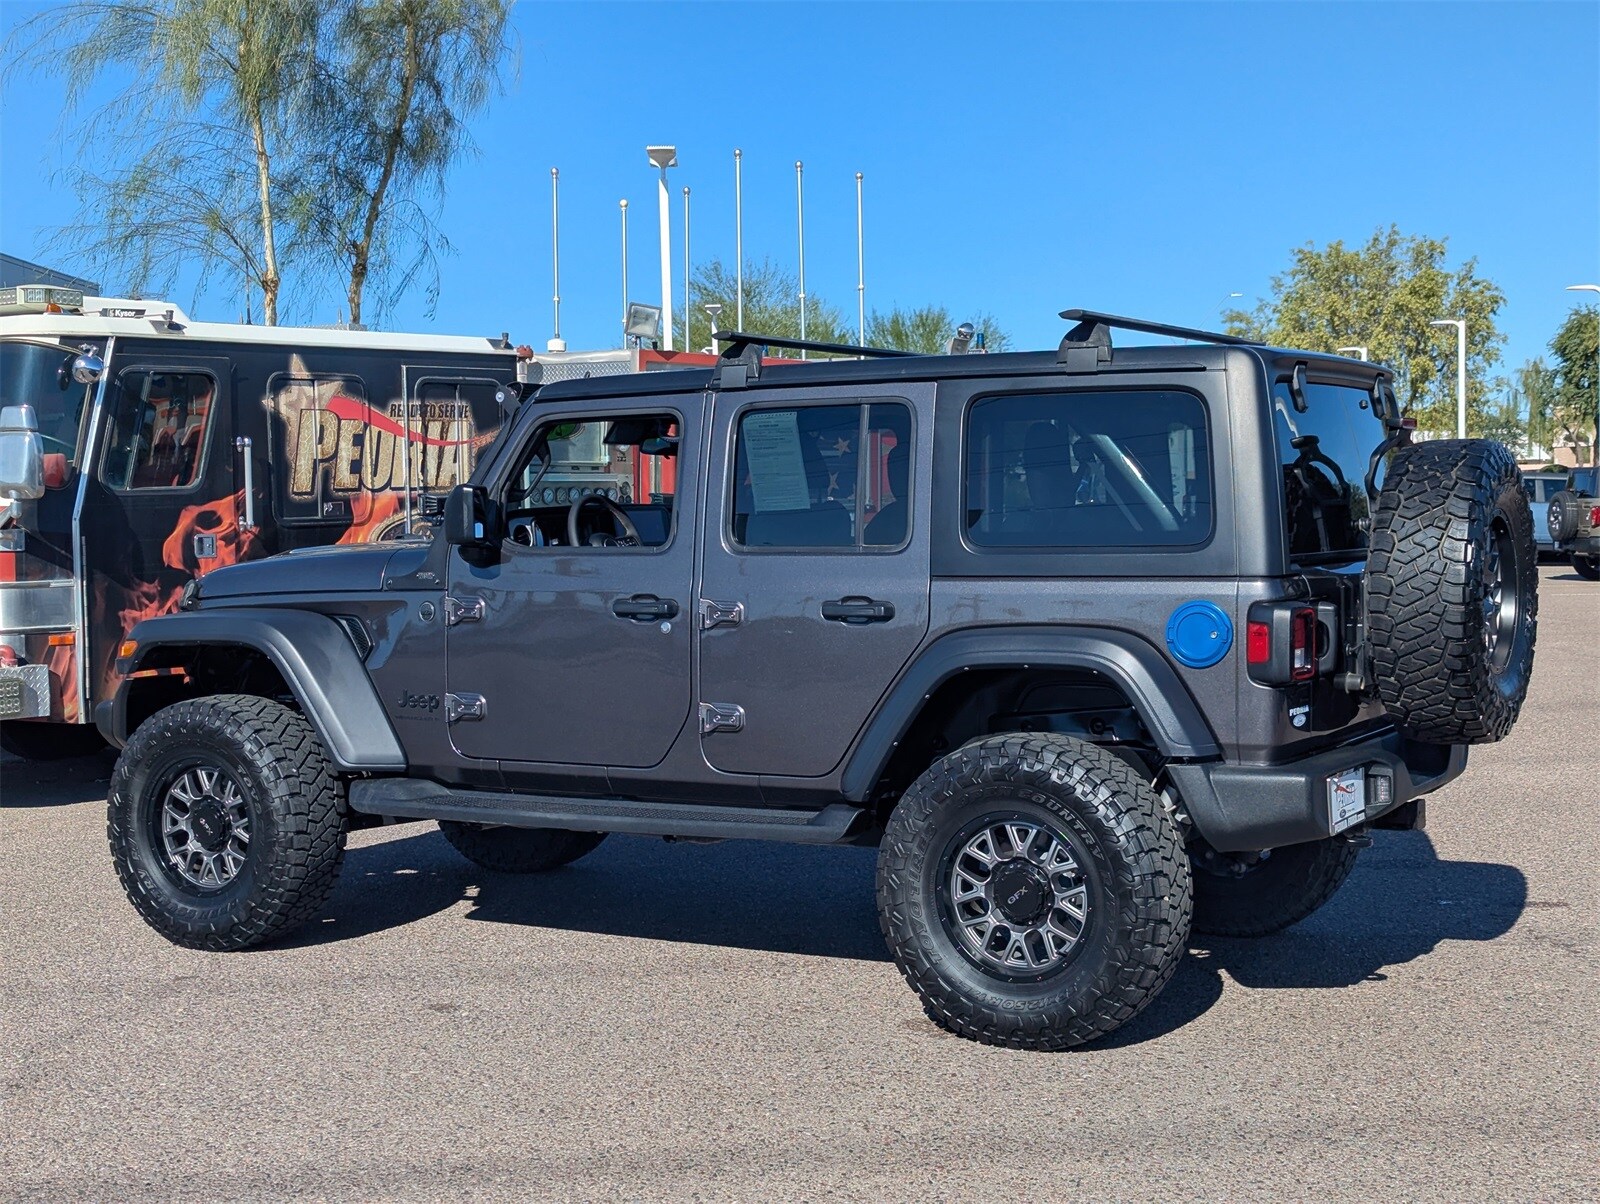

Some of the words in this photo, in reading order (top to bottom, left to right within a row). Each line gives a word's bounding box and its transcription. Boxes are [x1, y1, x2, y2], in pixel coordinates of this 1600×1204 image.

[115, 309, 136, 318] Kysor
[390, 403, 423, 418] RED
[292, 408, 472, 495] PEORIA
[397, 689, 440, 713] Jeep
[1017, 788, 1105, 862] COUNTRY
[1007, 885, 1029, 905] GFX
